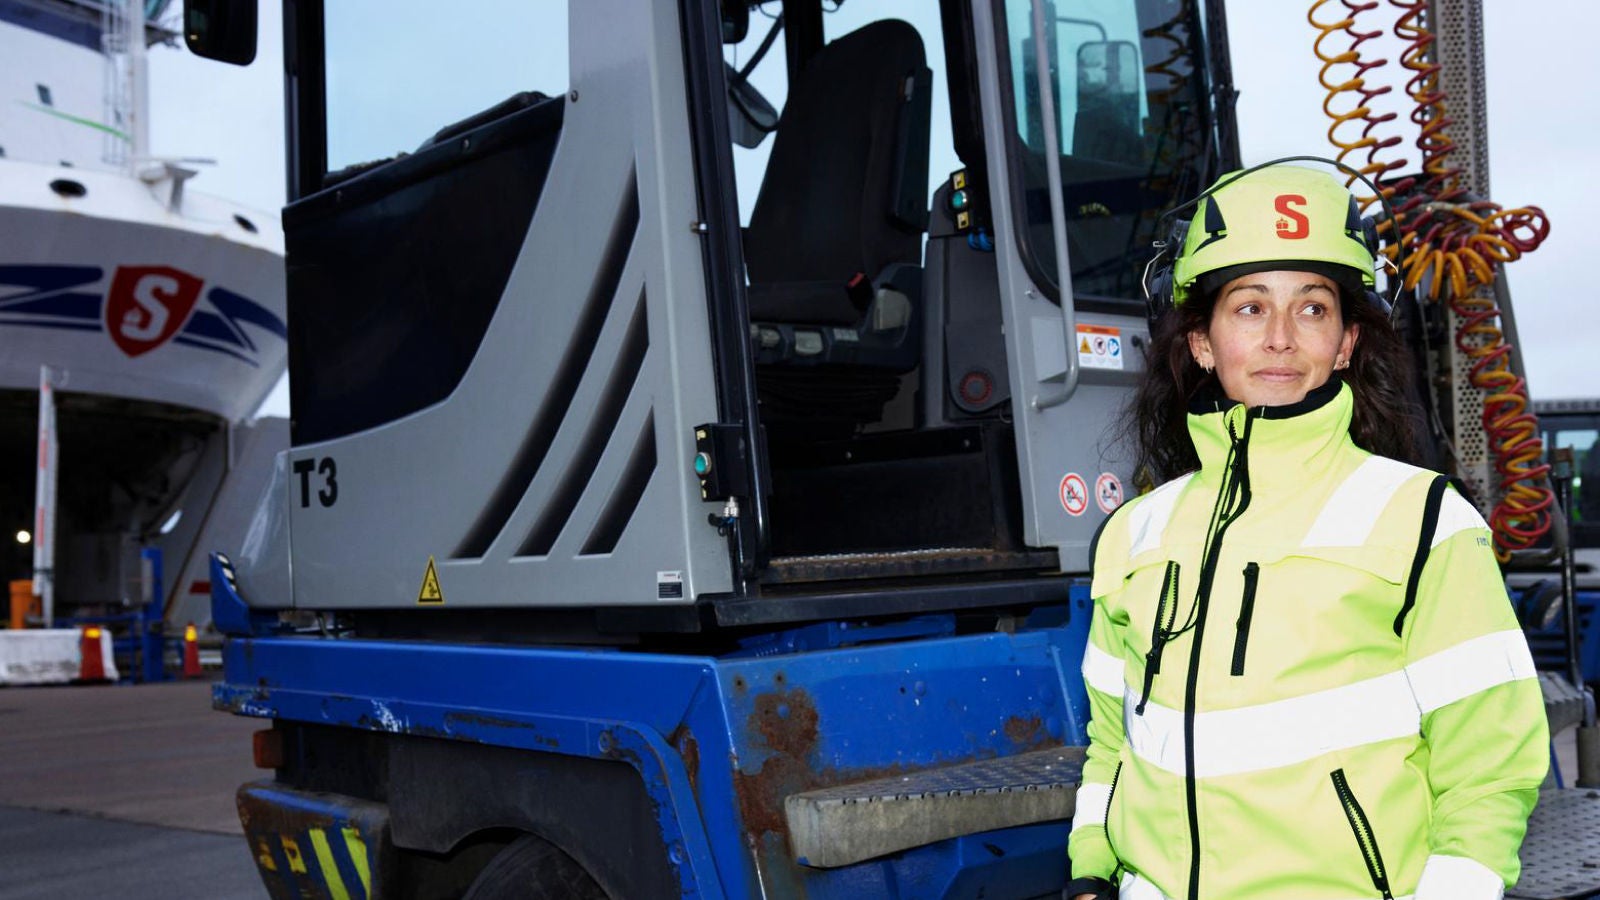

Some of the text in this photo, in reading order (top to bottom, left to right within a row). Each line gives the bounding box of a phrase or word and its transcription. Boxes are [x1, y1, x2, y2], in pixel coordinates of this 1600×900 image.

[1274, 194, 1310, 240] S
[120, 273, 180, 342] S
[293, 456, 338, 509] T3
